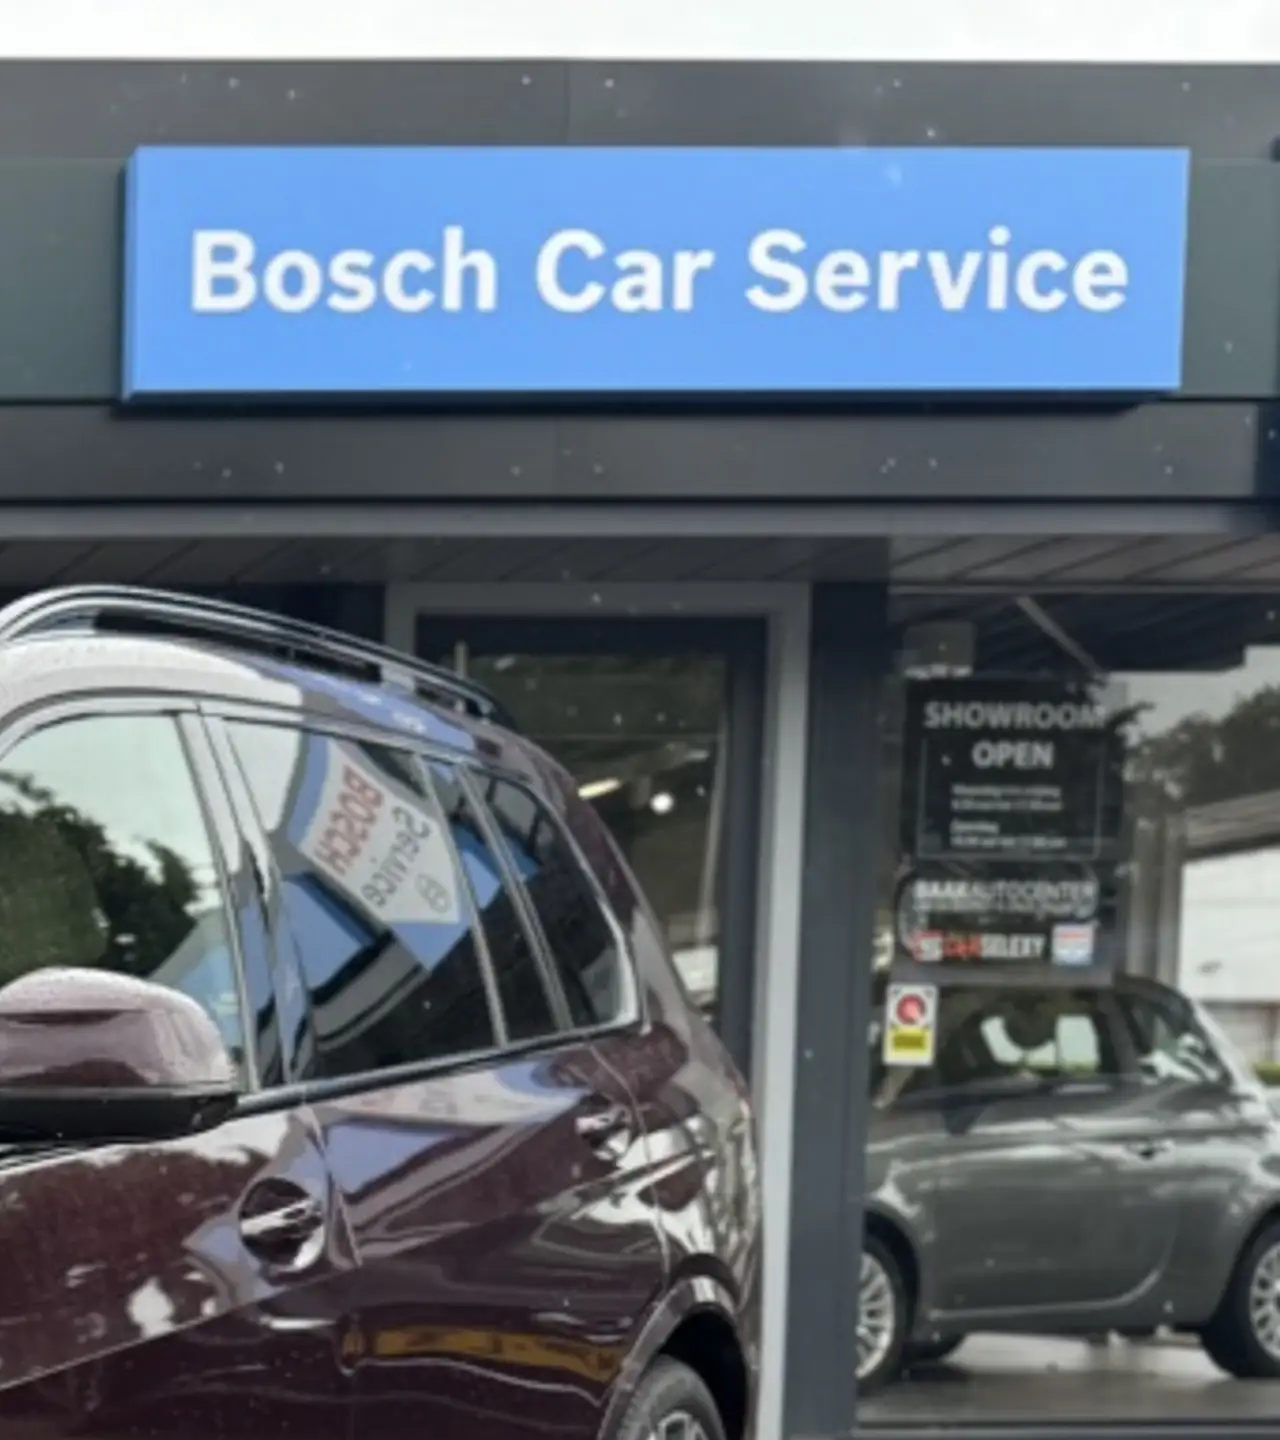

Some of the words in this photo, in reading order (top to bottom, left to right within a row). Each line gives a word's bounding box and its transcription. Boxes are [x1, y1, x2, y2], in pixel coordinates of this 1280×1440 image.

[190, 226, 497, 314] Bosch
[535, 228, 715, 314] Car
[744, 226, 1129, 313] Service
[923, 700, 1107, 729] SHOWROOM
[971, 740, 1054, 769] OPEN
